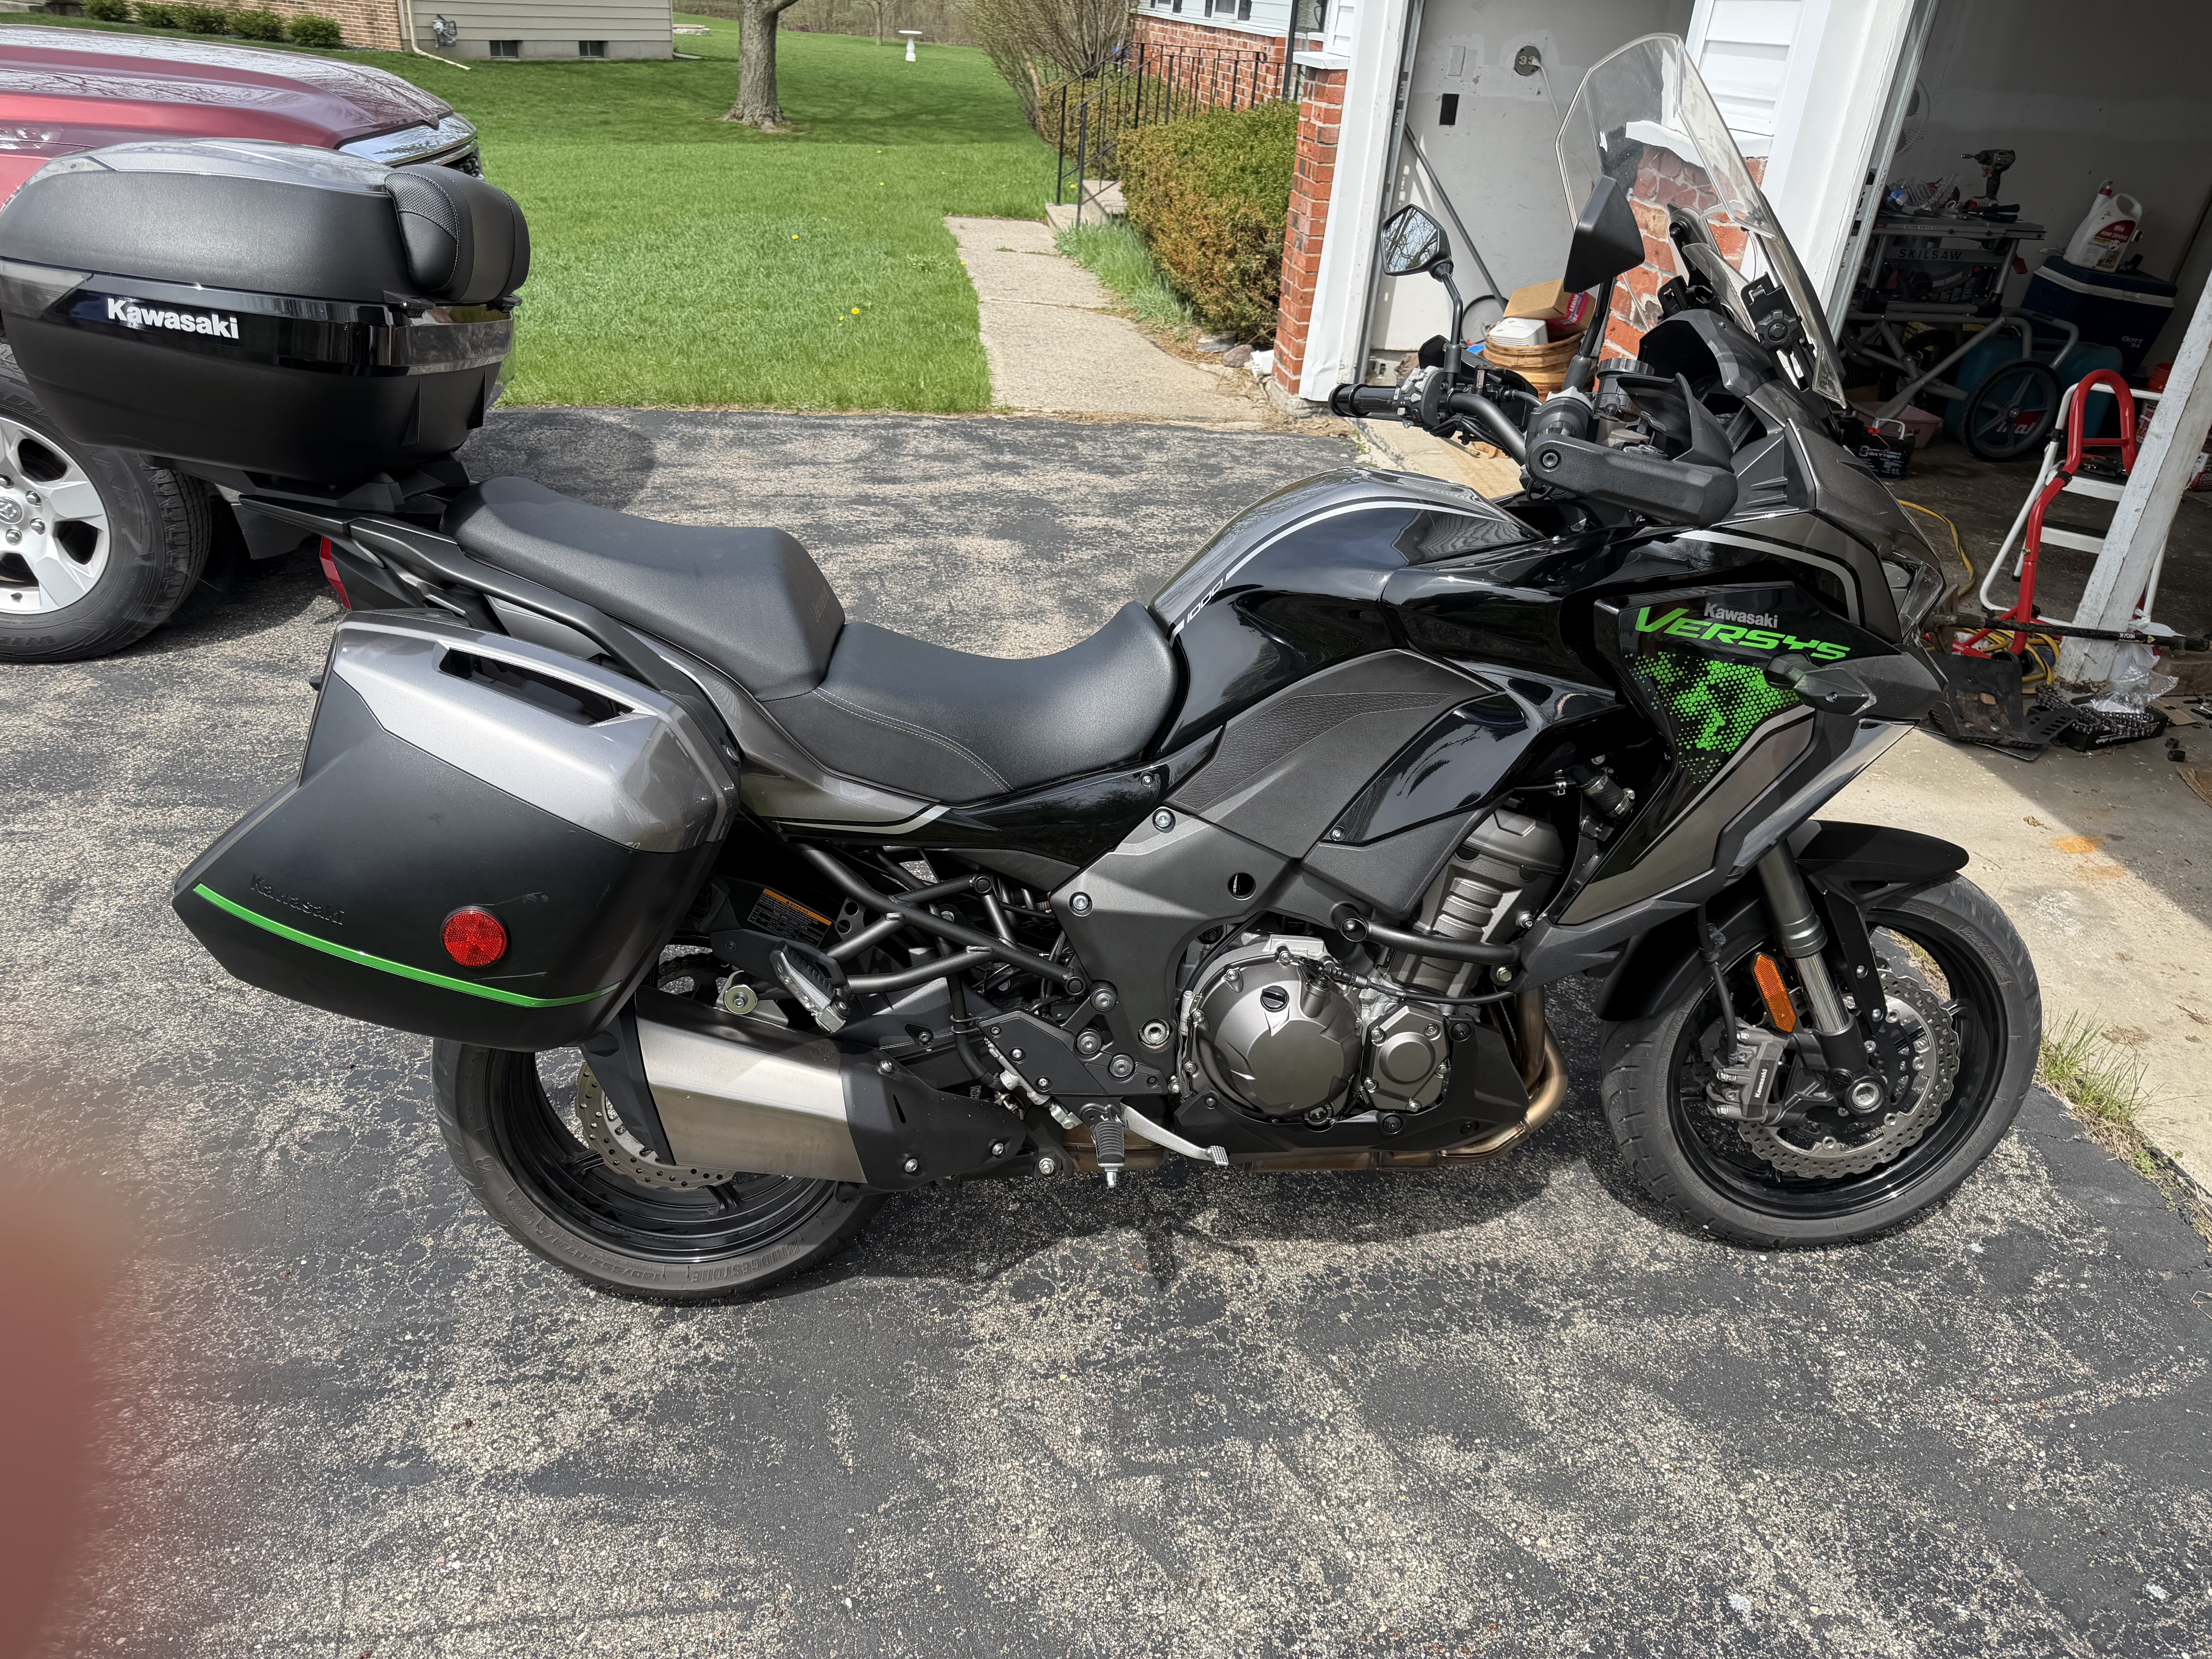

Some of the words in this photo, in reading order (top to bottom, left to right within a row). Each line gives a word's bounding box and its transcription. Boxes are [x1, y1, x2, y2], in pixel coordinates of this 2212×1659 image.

[1899, 249, 1962, 261] SKILSAW
[108, 298, 239, 339] Kawasaki
[1187, 578, 1223, 623] 1000
[1704, 603, 1778, 628] Kawasaki
[1635, 606, 1851, 660] VERSYS
[790, 903, 809, 914] WARNING
[1960, 926, 2010, 980] BRIDGESTONE
[1754, 1068, 1768, 1098] Kawasaki
[692, 1238, 801, 1284] BRIDGESTONE
